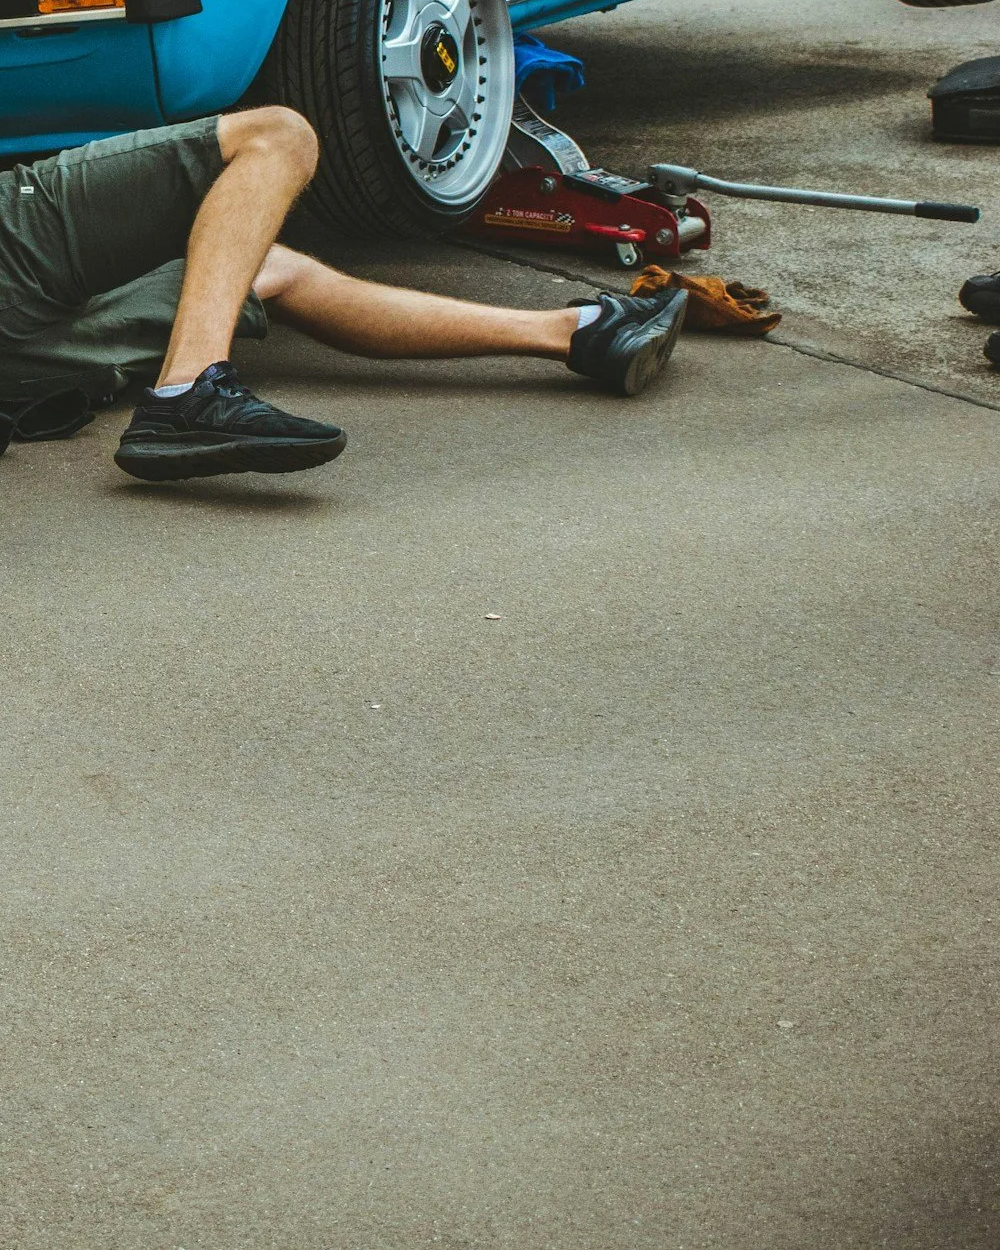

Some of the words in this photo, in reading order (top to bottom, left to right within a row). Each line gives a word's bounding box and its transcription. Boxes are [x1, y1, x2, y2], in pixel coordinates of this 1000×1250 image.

[506, 209, 511, 217] 2
[512, 210, 524, 218] TON
[525, 211, 553, 221] CAPACITY
